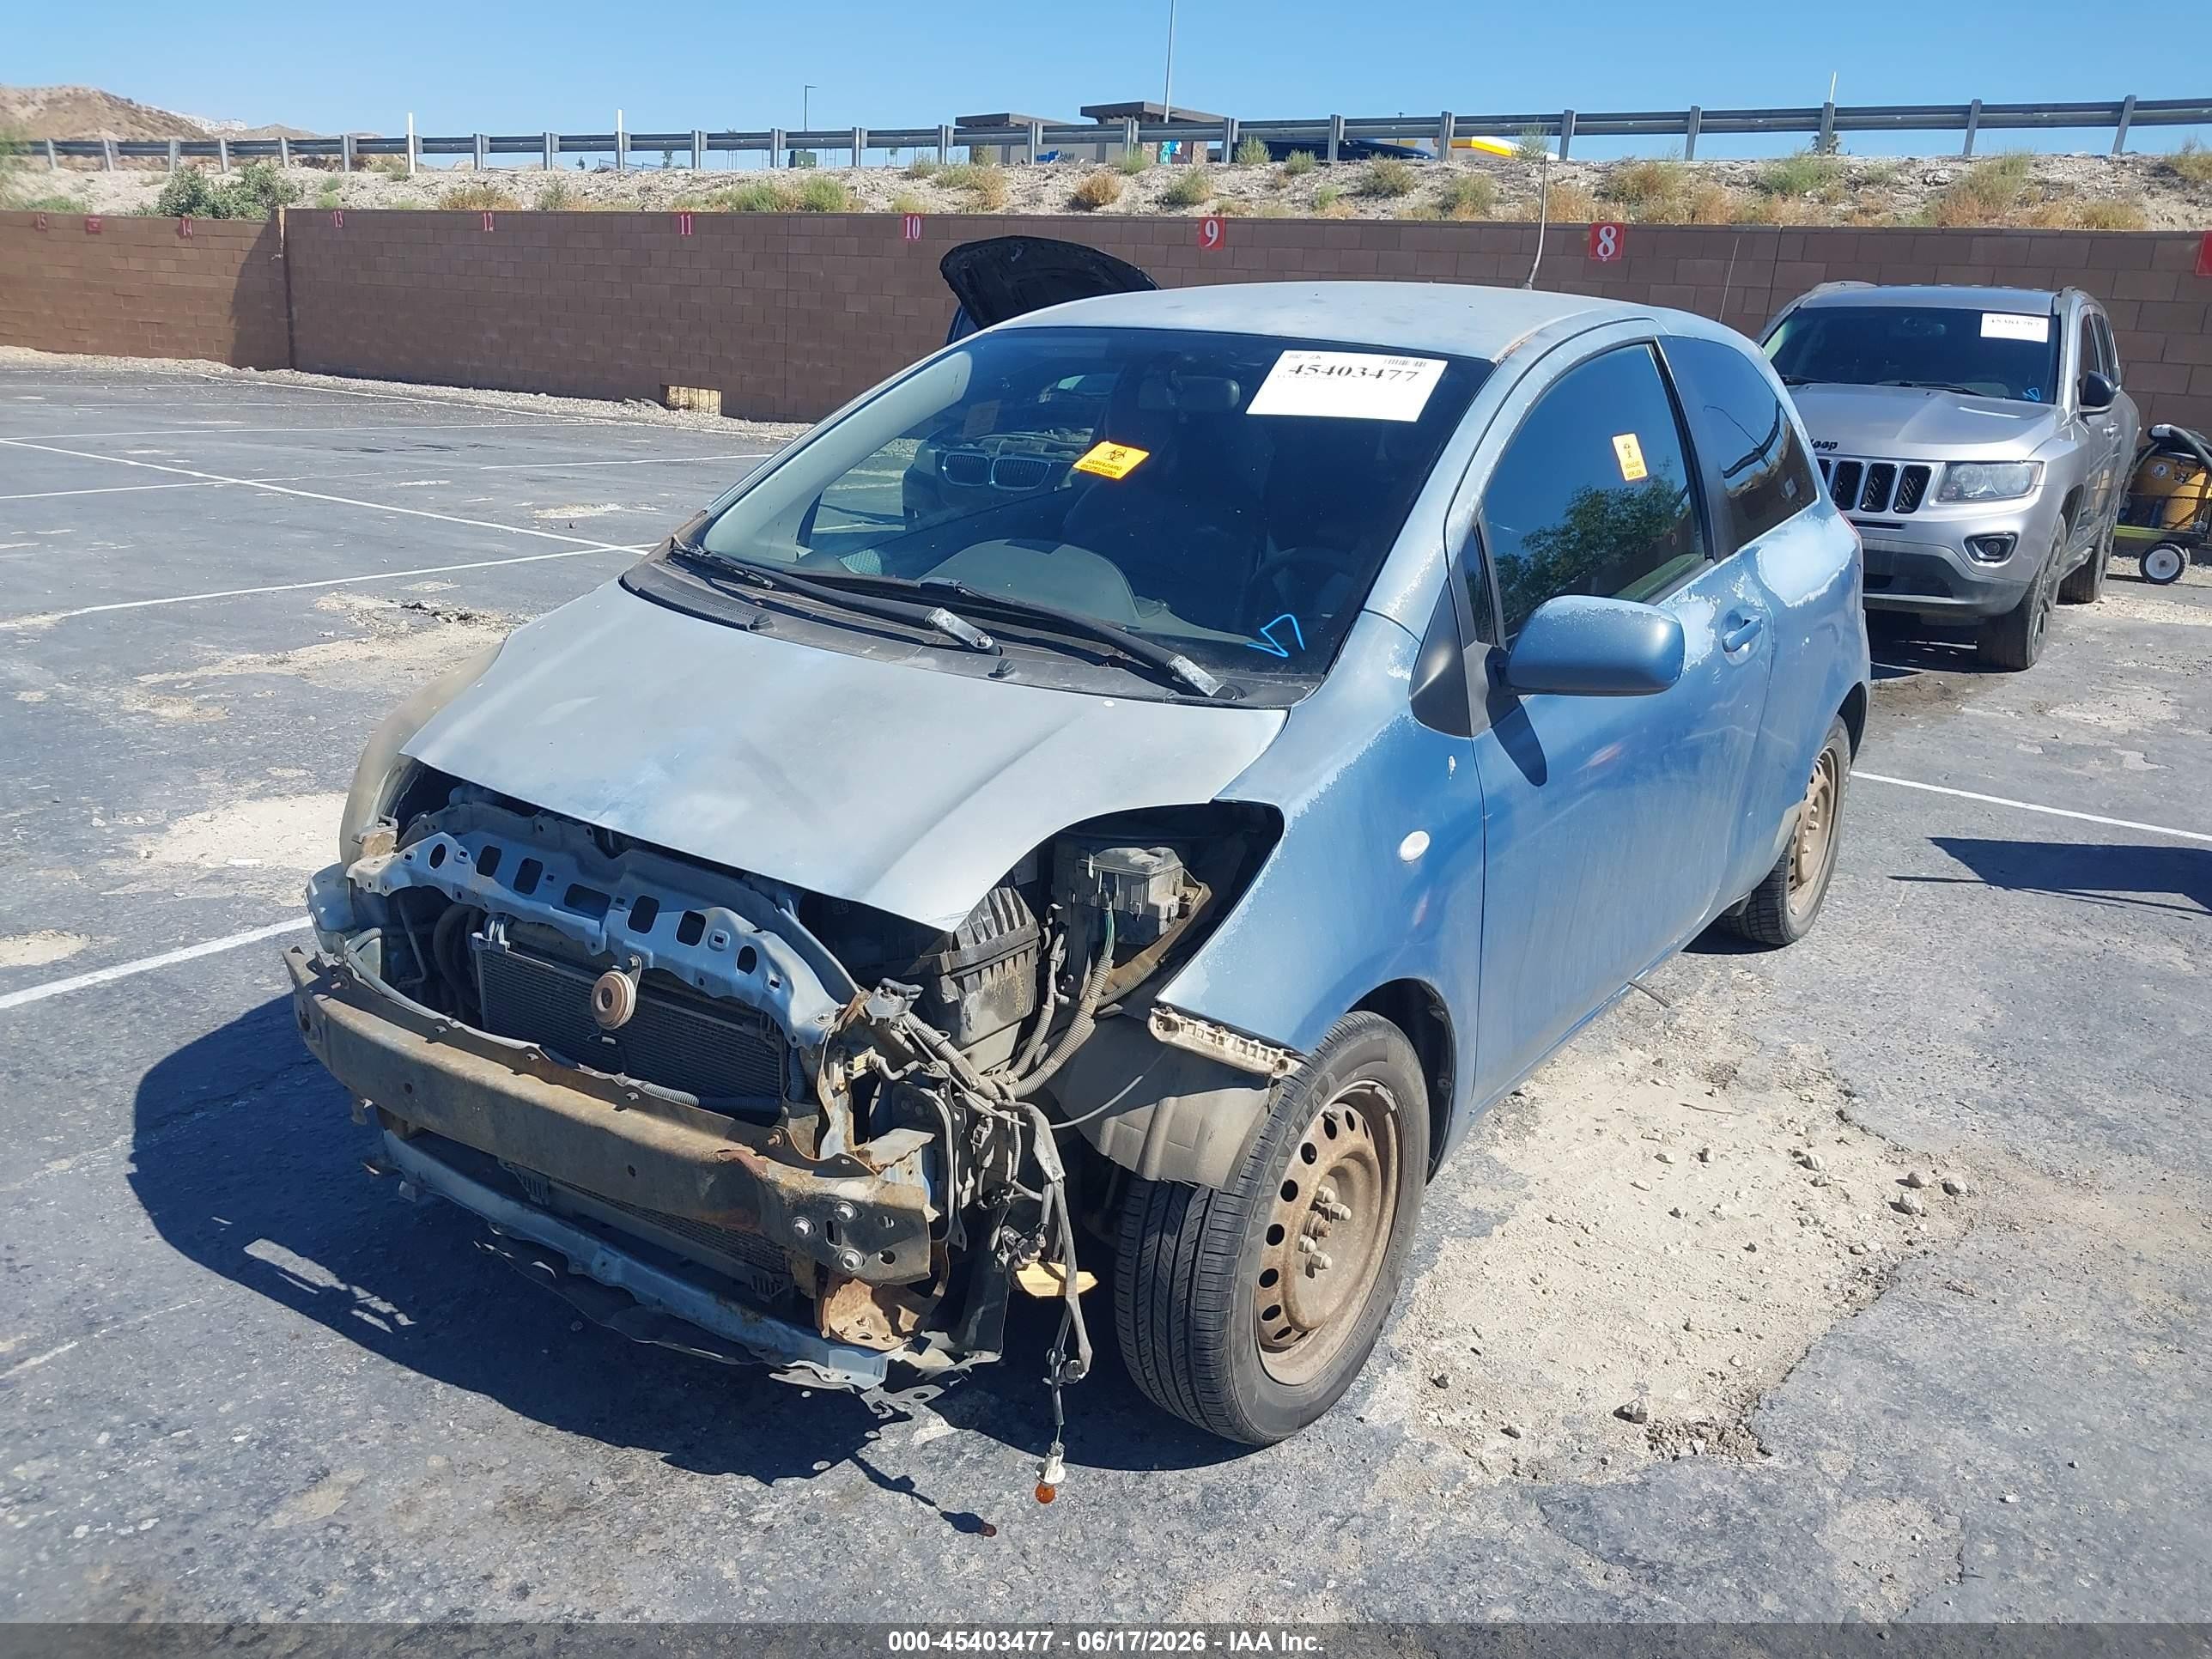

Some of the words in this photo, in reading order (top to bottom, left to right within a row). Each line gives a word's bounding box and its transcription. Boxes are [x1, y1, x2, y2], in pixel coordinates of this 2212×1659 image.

[182, 219, 192, 235] 14
[333, 210, 343, 228] 13
[483, 211, 493, 231] 12
[680, 213, 692, 235] 11
[905, 216, 921, 240] 10
[1205, 220, 1218, 247] 9
[1597, 225, 1617, 257] 8
[1288, 363, 1419, 382] 45403477
[1810, 438, 1838, 452] eep
